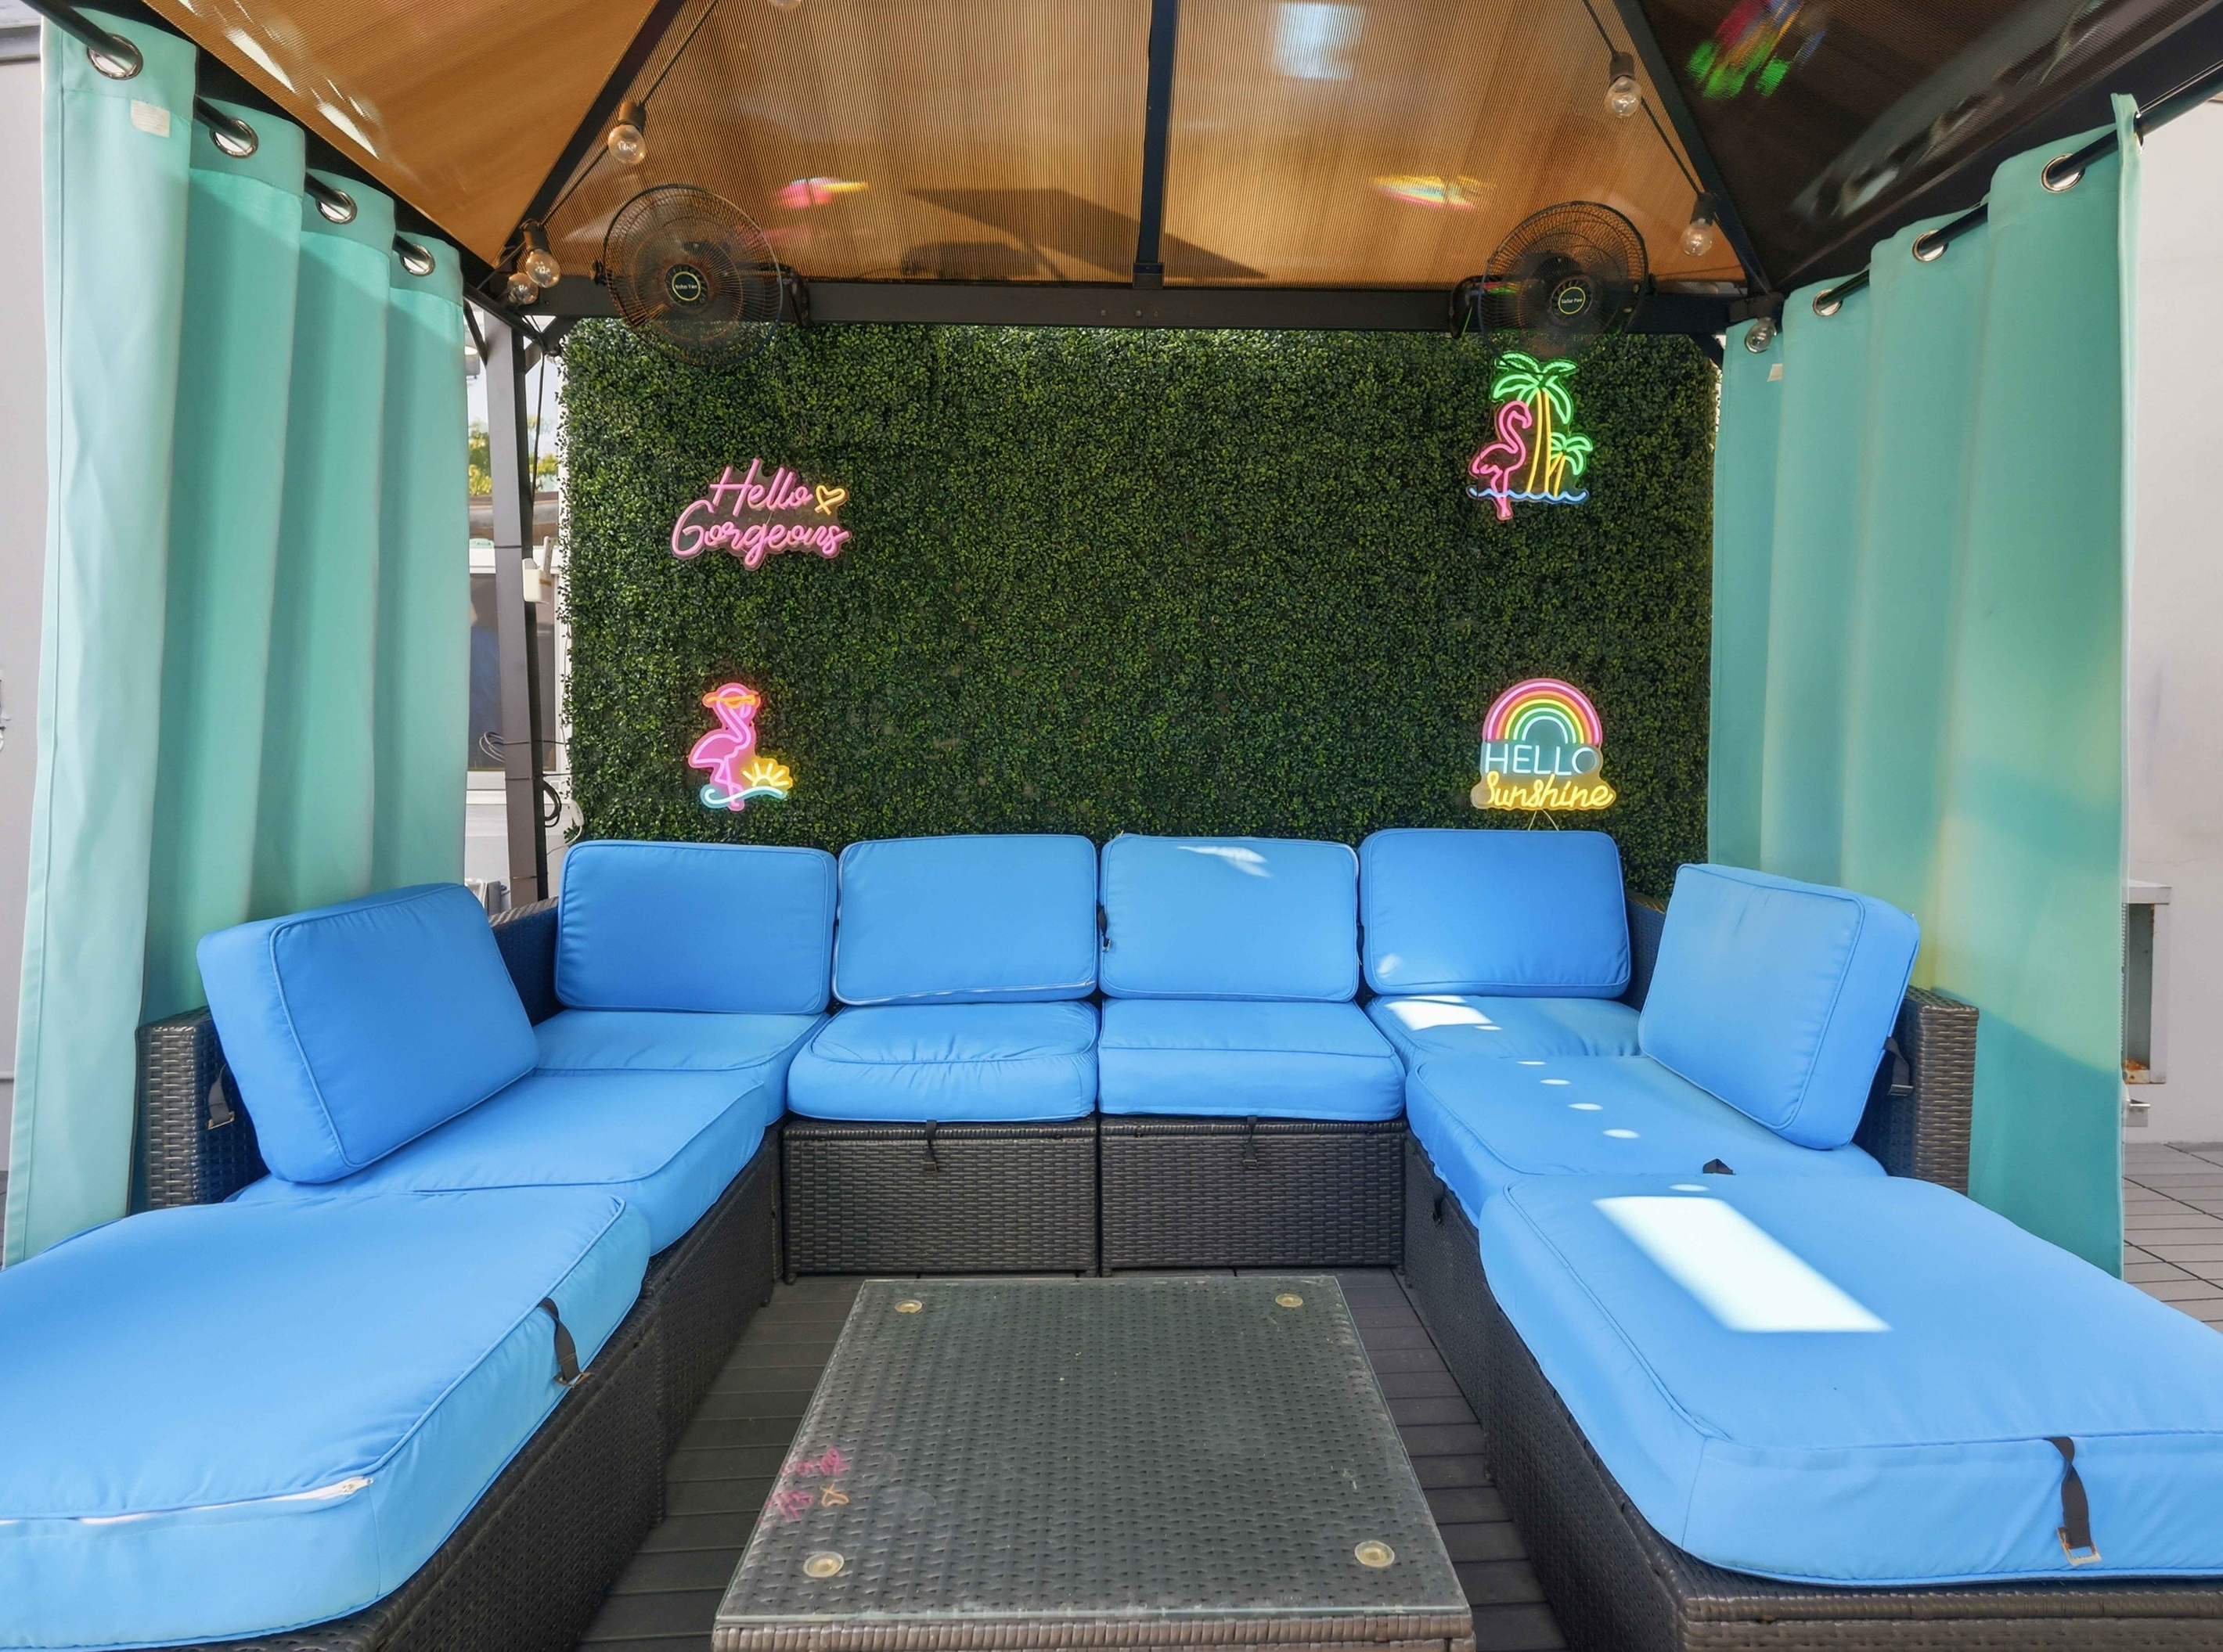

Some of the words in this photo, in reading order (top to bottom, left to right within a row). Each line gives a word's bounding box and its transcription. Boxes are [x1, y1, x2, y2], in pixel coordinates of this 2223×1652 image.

[709, 457, 814, 517] Hello
[672, 499, 851, 567] Gorgeous
[1485, 743, 1598, 776] HELLO
[1479, 771, 1615, 807] Sunshine
